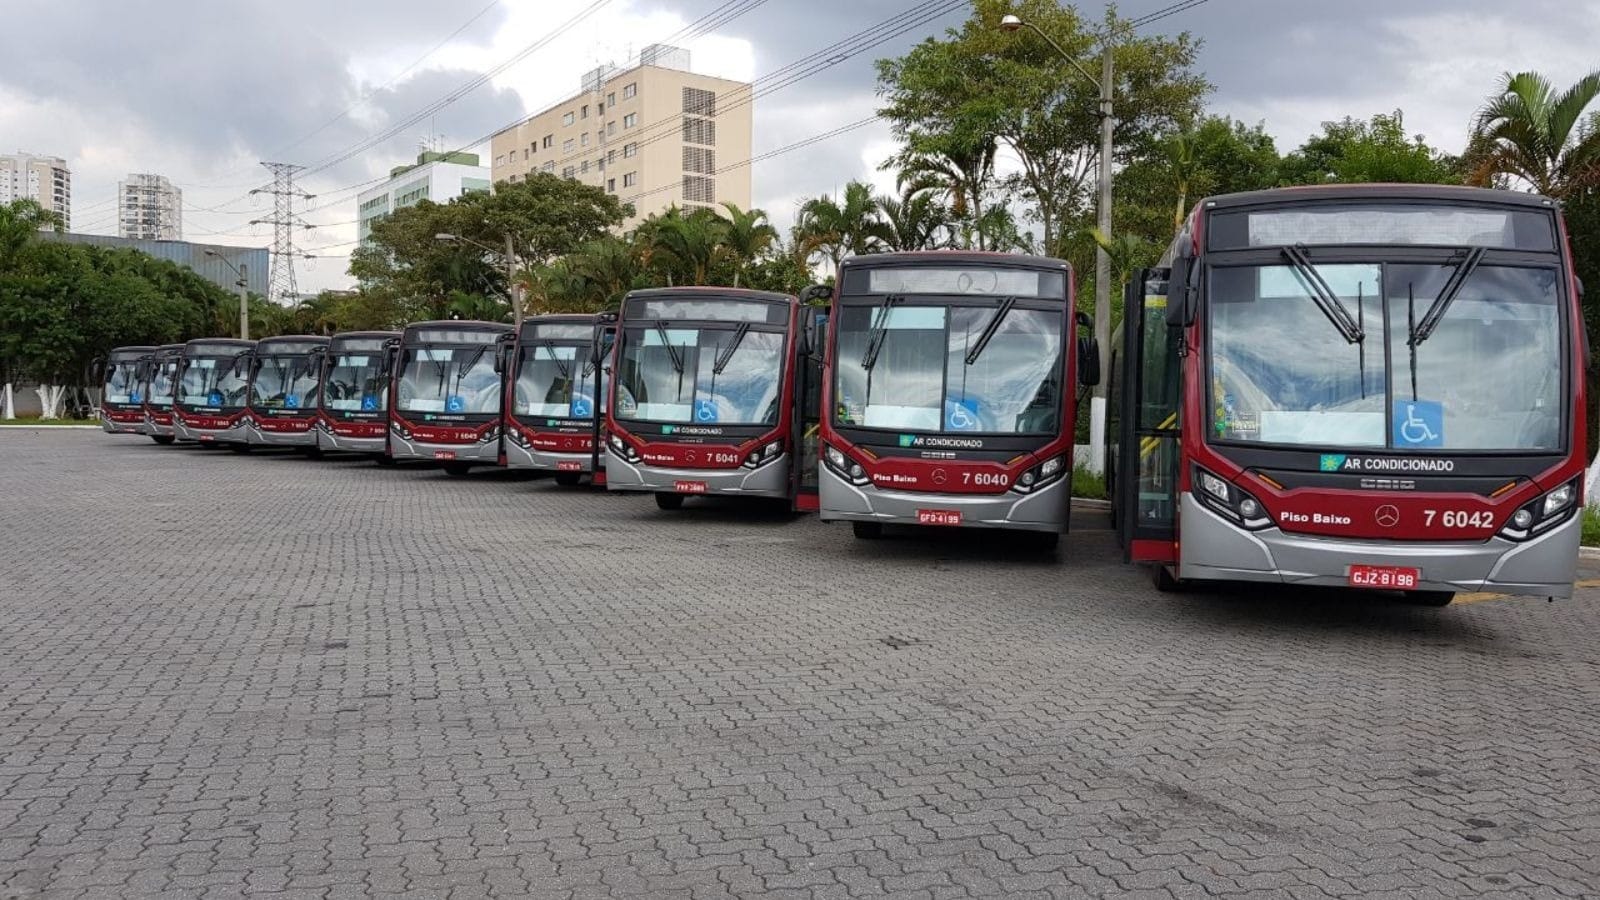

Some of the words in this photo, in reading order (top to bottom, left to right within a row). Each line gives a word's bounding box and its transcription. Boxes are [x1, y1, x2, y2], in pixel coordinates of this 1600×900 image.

[913, 435, 925, 445] AR
[926, 436, 982, 448] CONDICIONADO
[706, 453, 713, 462] 7
[715, 453, 739, 463] 6041
[1344, 459, 1361, 470] AR
[1364, 459, 1454, 471] CONDICIONADO
[873, 473, 891, 482] Piso
[962, 472, 971, 484] 7
[974, 473, 1008, 486] 6040
[1280, 511, 1309, 523] Piso
[1313, 512, 1351, 525] Baixo
[1423, 510, 1437, 527] 7
[1442, 510, 1494, 529] 6042
